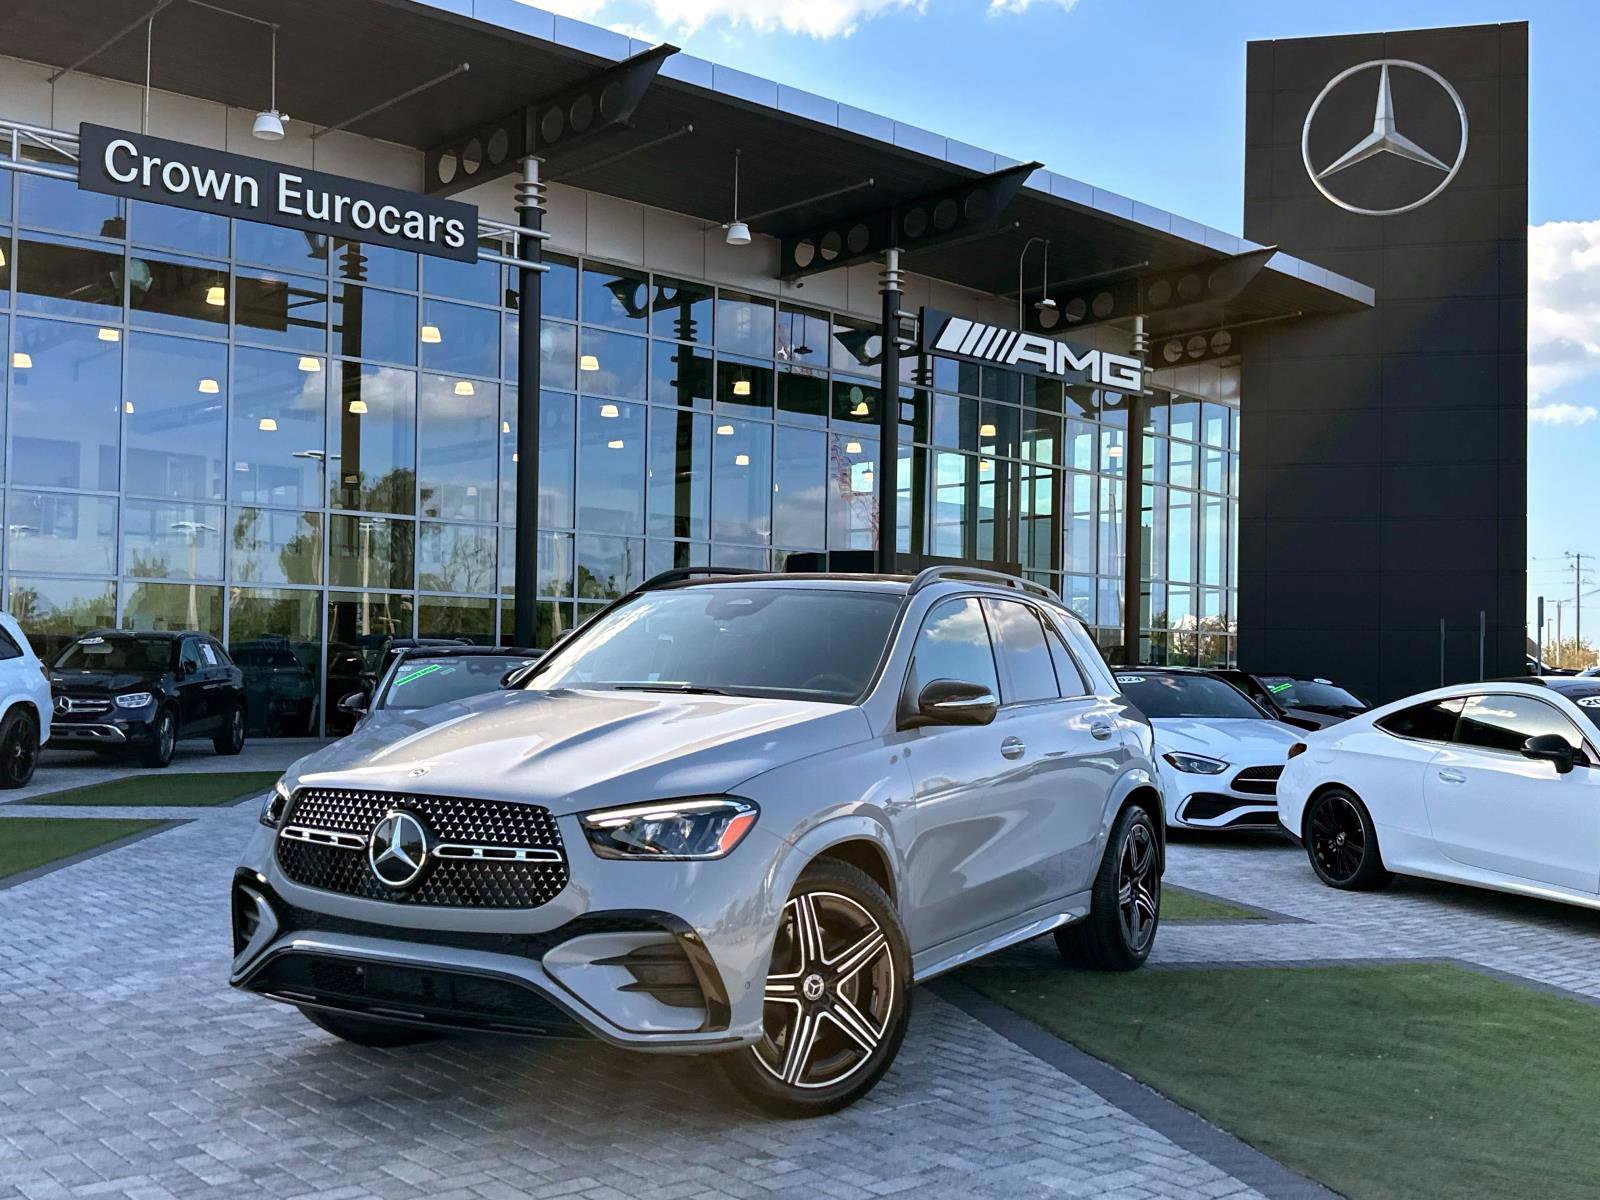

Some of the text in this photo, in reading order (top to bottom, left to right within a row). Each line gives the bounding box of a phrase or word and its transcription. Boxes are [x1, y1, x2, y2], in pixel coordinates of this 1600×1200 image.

[105, 138, 466, 248] Crown Eurocars
[1005, 332, 1142, 391] AMG
